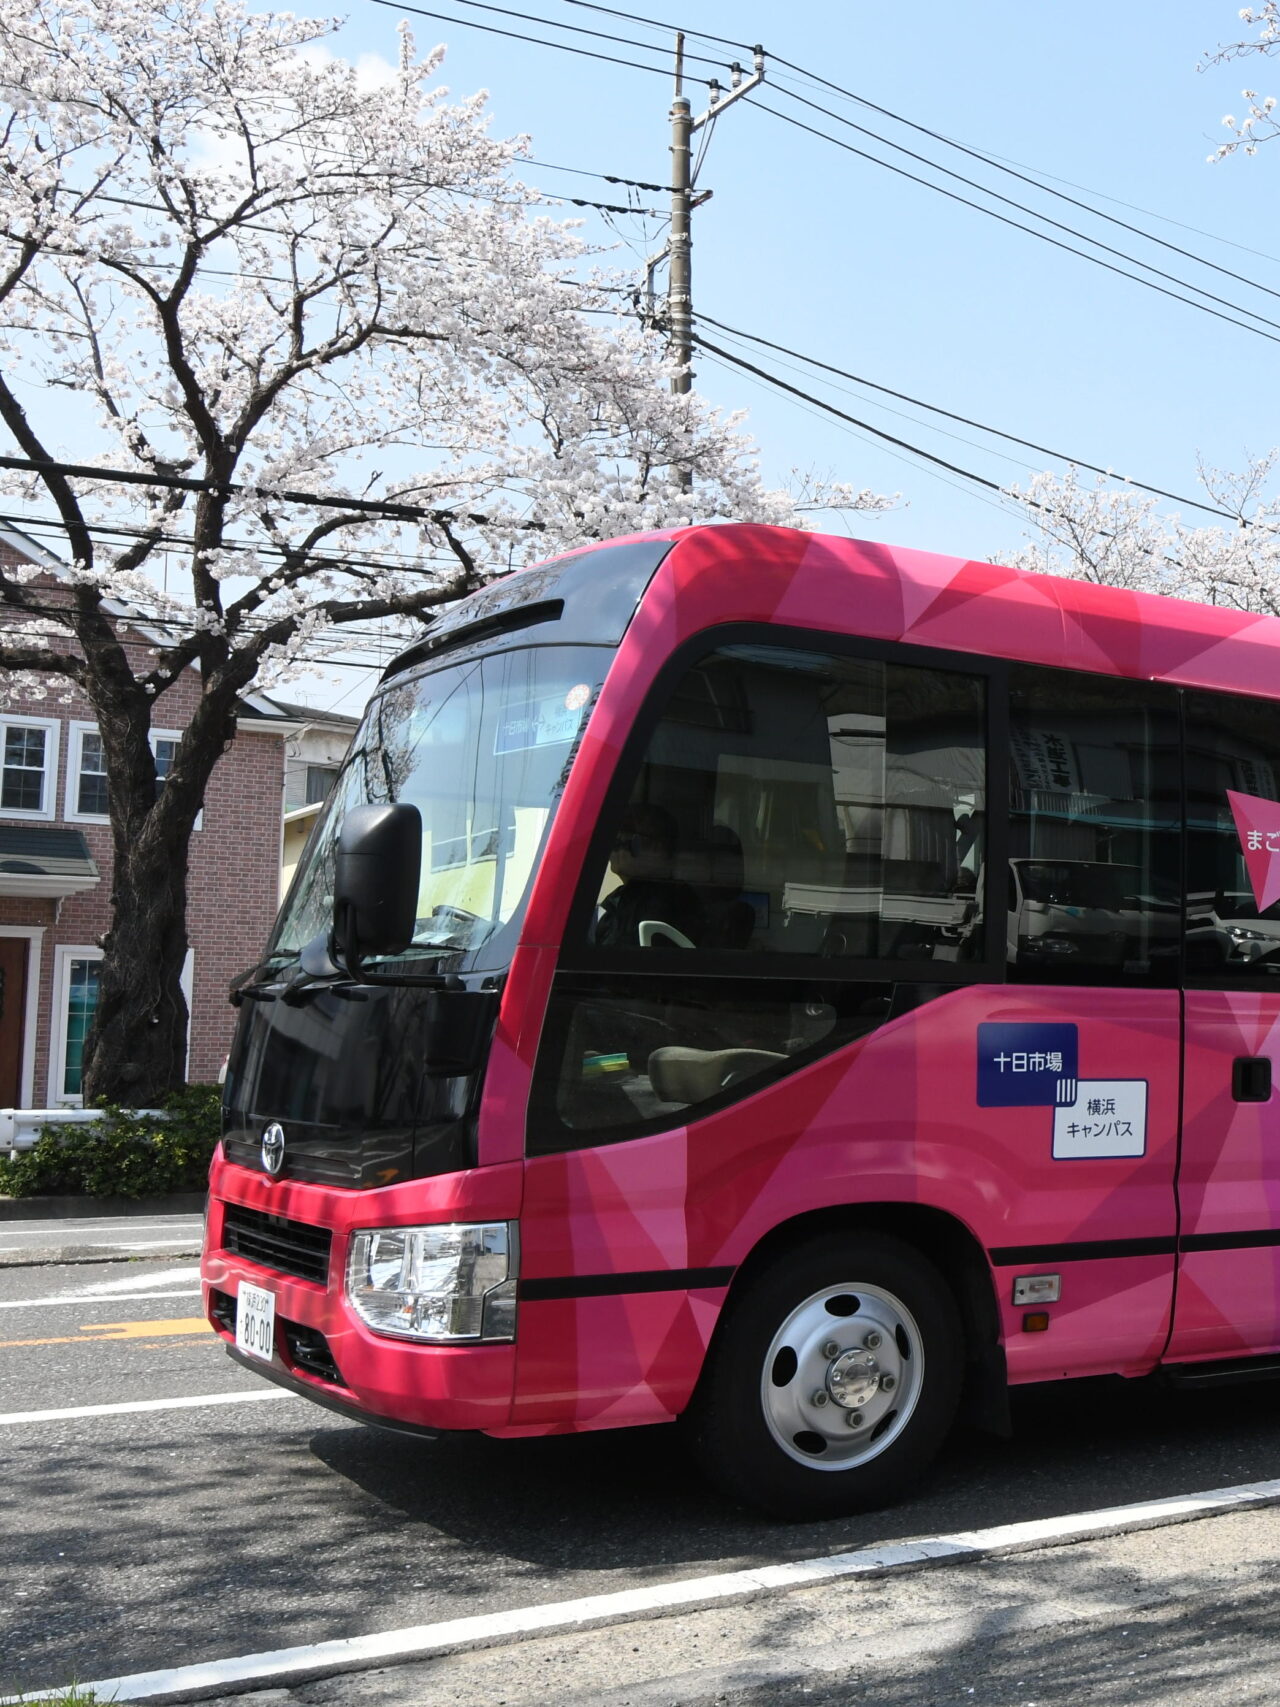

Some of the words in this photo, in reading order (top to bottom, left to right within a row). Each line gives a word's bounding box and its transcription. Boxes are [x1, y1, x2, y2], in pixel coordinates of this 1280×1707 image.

[993, 1051, 1063, 1073] 十日市場
[1087, 1098, 1116, 1116] 横浜
[1066, 1120, 1133, 1138] キャンパス
